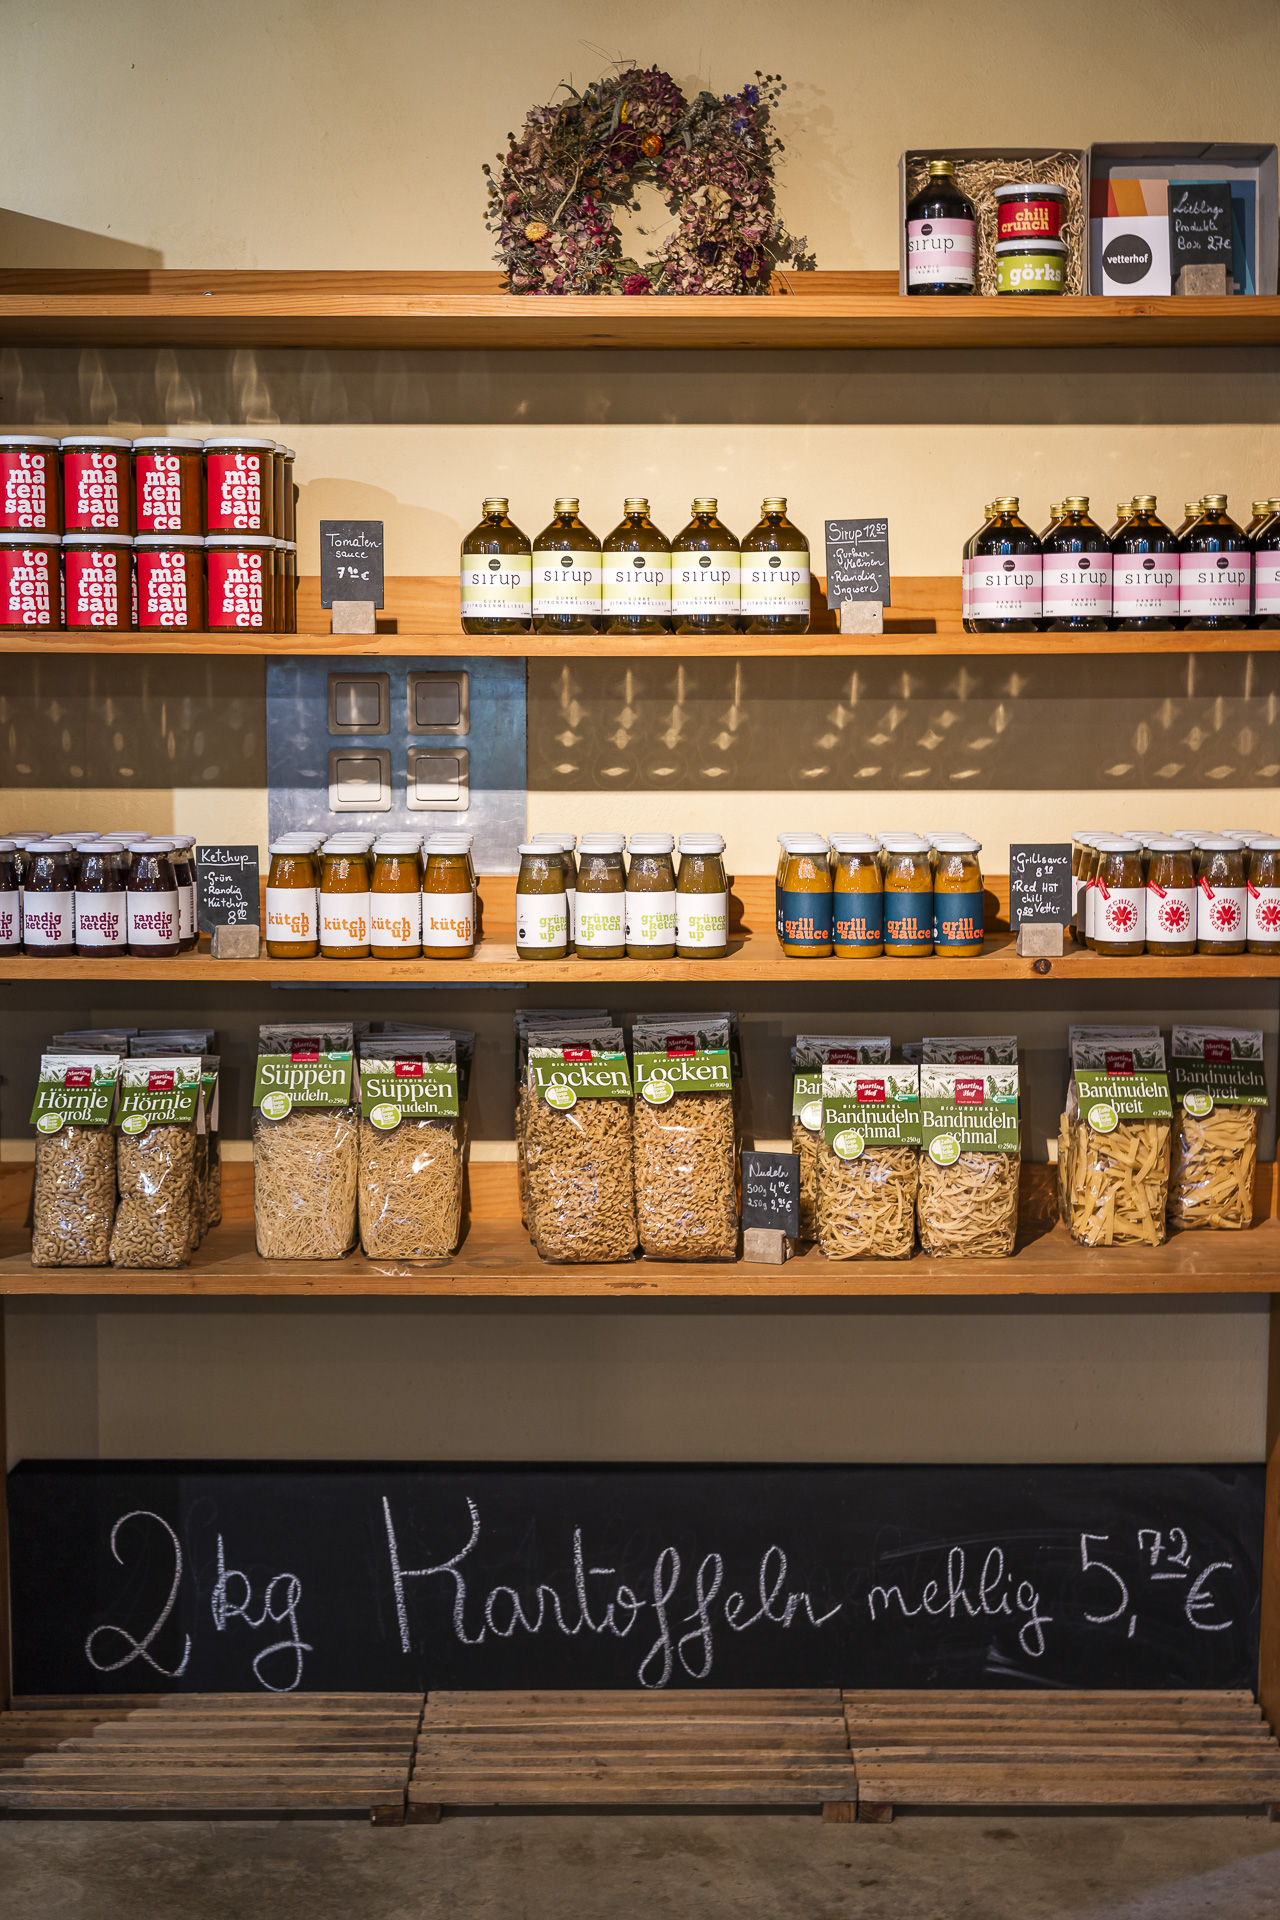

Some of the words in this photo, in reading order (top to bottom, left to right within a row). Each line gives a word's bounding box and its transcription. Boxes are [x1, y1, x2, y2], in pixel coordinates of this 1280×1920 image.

[1015, 208, 1049, 221] chili
[1001, 220, 1049, 233] crunch
[909, 238, 954, 253] sirup
[1107, 254, 1149, 264] vetterhof
[1010, 263, 1061, 286] görks
[154, 455, 180, 471] to
[235, 454, 260, 470] to
[146, 471, 180, 485] ma
[225, 471, 260, 485] ma
[143, 483, 180, 500] ten
[221, 482, 260, 500] ten
[143, 502, 181, 516] sau
[221, 500, 260, 515] sau
[153, 517, 181, 529] ce
[233, 515, 260, 529] ce
[829, 523, 862, 546] Sirup
[22, 550, 48, 566] to
[91, 552, 116, 568] to
[159, 552, 185, 568] to
[237, 553, 261, 568] to
[335, 550, 368, 558] sauce
[13, 567, 48, 580] ma
[81, 568, 117, 582] ma
[150, 568, 186, 583] ma
[227, 569, 262, 583] ma
[544, 570, 592, 586] sirup
[615, 571, 664, 586] sirup
[682, 570, 731, 586] sirup
[752, 571, 800, 586] sirup
[1060, 572, 1107, 587] sirup
[1125, 572, 1173, 588] sirup
[1198, 571, 1245, 587] sirup
[9, 579, 49, 596] ten
[472, 573, 521, 589] sirup
[986, 575, 1034, 589] sirup
[78, 580, 117, 597] ten
[148, 580, 186, 597] ten
[224, 580, 262, 598] ten
[9, 596, 49, 610] sau
[78, 597, 117, 612] sau
[148, 598, 187, 612] sau
[222, 598, 262, 612] sau
[22, 611, 50, 624] ce
[91, 612, 118, 625] ce
[160, 612, 187, 625] ce
[236, 613, 262, 626] ce
[201, 848, 249, 871] Ketchup
[1014, 880, 1037, 892] Red
[25, 912, 62, 925] randig
[80, 912, 119, 925] randig
[134, 911, 173, 924] randig
[134, 920, 169, 929] ketch
[268, 912, 309, 925] kütch
[324, 917, 366, 930] kütch
[371, 917, 411, 930] kütch
[430, 917, 471, 930] kütch
[581, 913, 621, 925] grünes
[26, 920, 57, 930] ketch
[80, 920, 115, 930] ketch
[291, 924, 309, 936] up
[587, 921, 621, 931] ketch
[785, 917, 814, 933] grill
[837, 918, 866, 934] grill
[887, 917, 917, 933] grill
[942, 918, 974, 934] grill
[45, 930, 61, 940] up
[104, 930, 119, 940] up
[158, 929, 173, 939] up
[348, 928, 366, 941] up
[392, 929, 411, 941] up
[456, 928, 471, 941] up
[540, 932, 555, 942] up
[581, 929, 595, 940] up
[642, 930, 657, 940] up
[689, 931, 704, 941] up
[789, 930, 828, 939] sauce
[841, 929, 880, 940] sauce
[892, 929, 930, 939] sauce
[260, 1064, 345, 1090] Suppen
[535, 1067, 628, 1087] Locken
[636, 1062, 728, 1082] Locken
[1176, 1068, 1264, 1085] Bandnudeln
[367, 1079, 453, 1102] Suppen
[1078, 1082, 1168, 1098] Bandnudeln
[1207, 1084, 1239, 1099] breit
[37, 1091, 108, 1109] Hörnle
[122, 1094, 192, 1111] Hörnle
[1111, 1099, 1144, 1114] breit
[59, 1108, 91, 1123] groß
[143, 1109, 175, 1123] groß
[826, 1109, 920, 1124] Bandnudeln
[923, 1111, 1017, 1129] Bandnudeln
[382, 1496, 842, 1688] Kartoffeln
[868, 1547, 1053, 1656] mehlig
